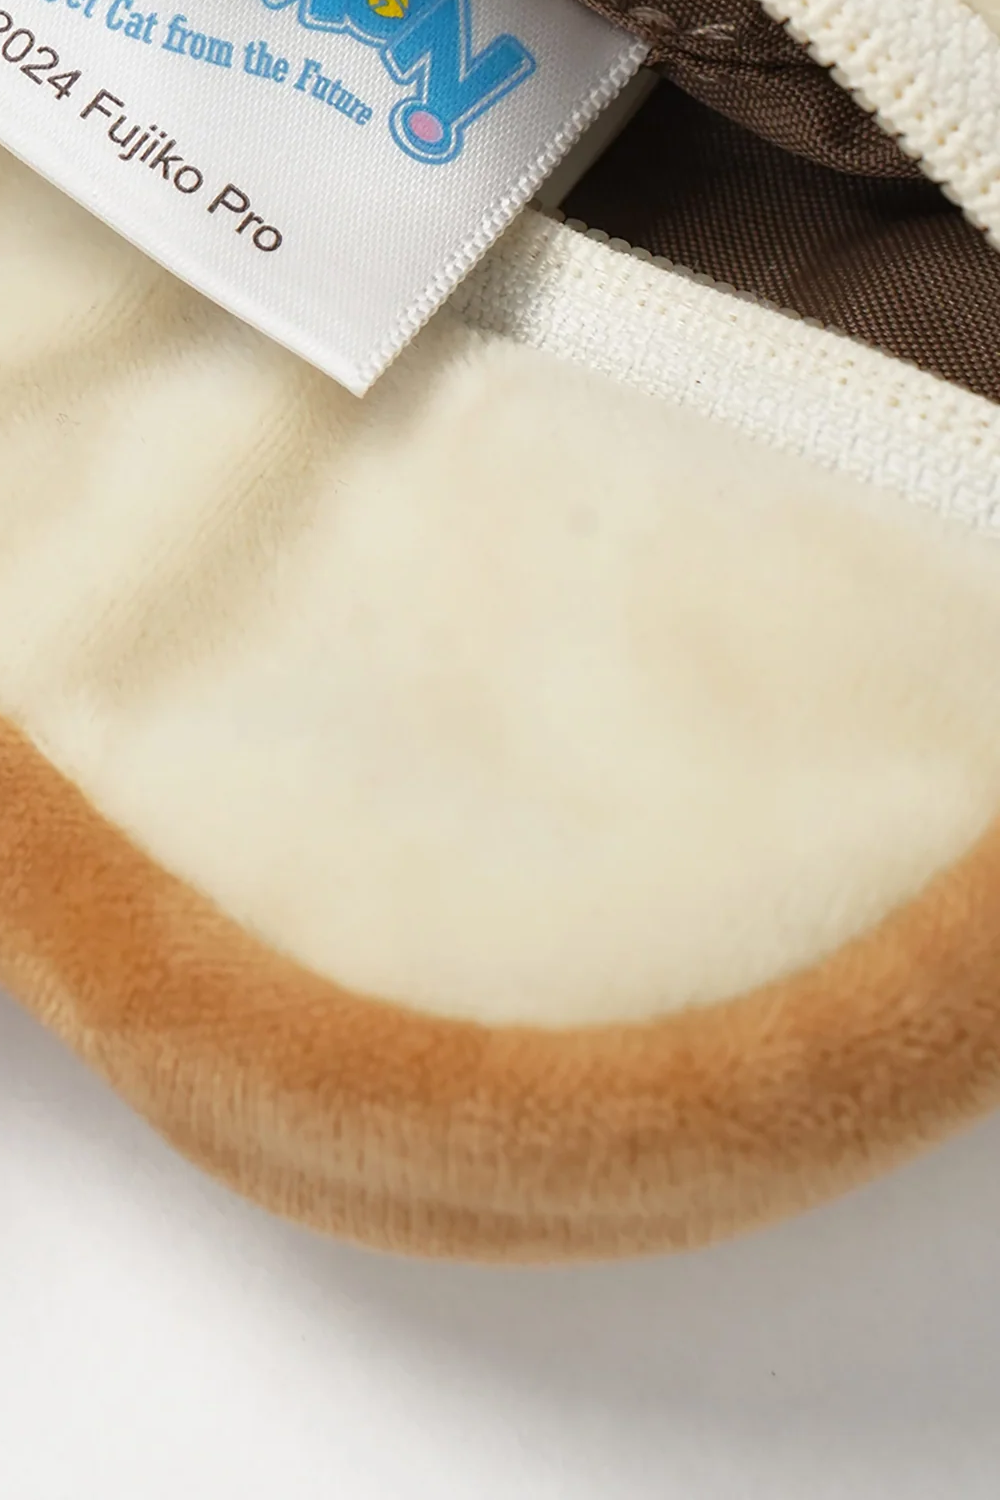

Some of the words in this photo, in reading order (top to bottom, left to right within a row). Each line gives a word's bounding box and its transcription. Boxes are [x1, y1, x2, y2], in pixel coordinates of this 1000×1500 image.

[162, 13, 236, 68] from
[243, 40, 289, 83] the
[294, 57, 373, 126] Future
[80, 88, 204, 194] Fujiko
[207, 183, 283, 252] Pro
